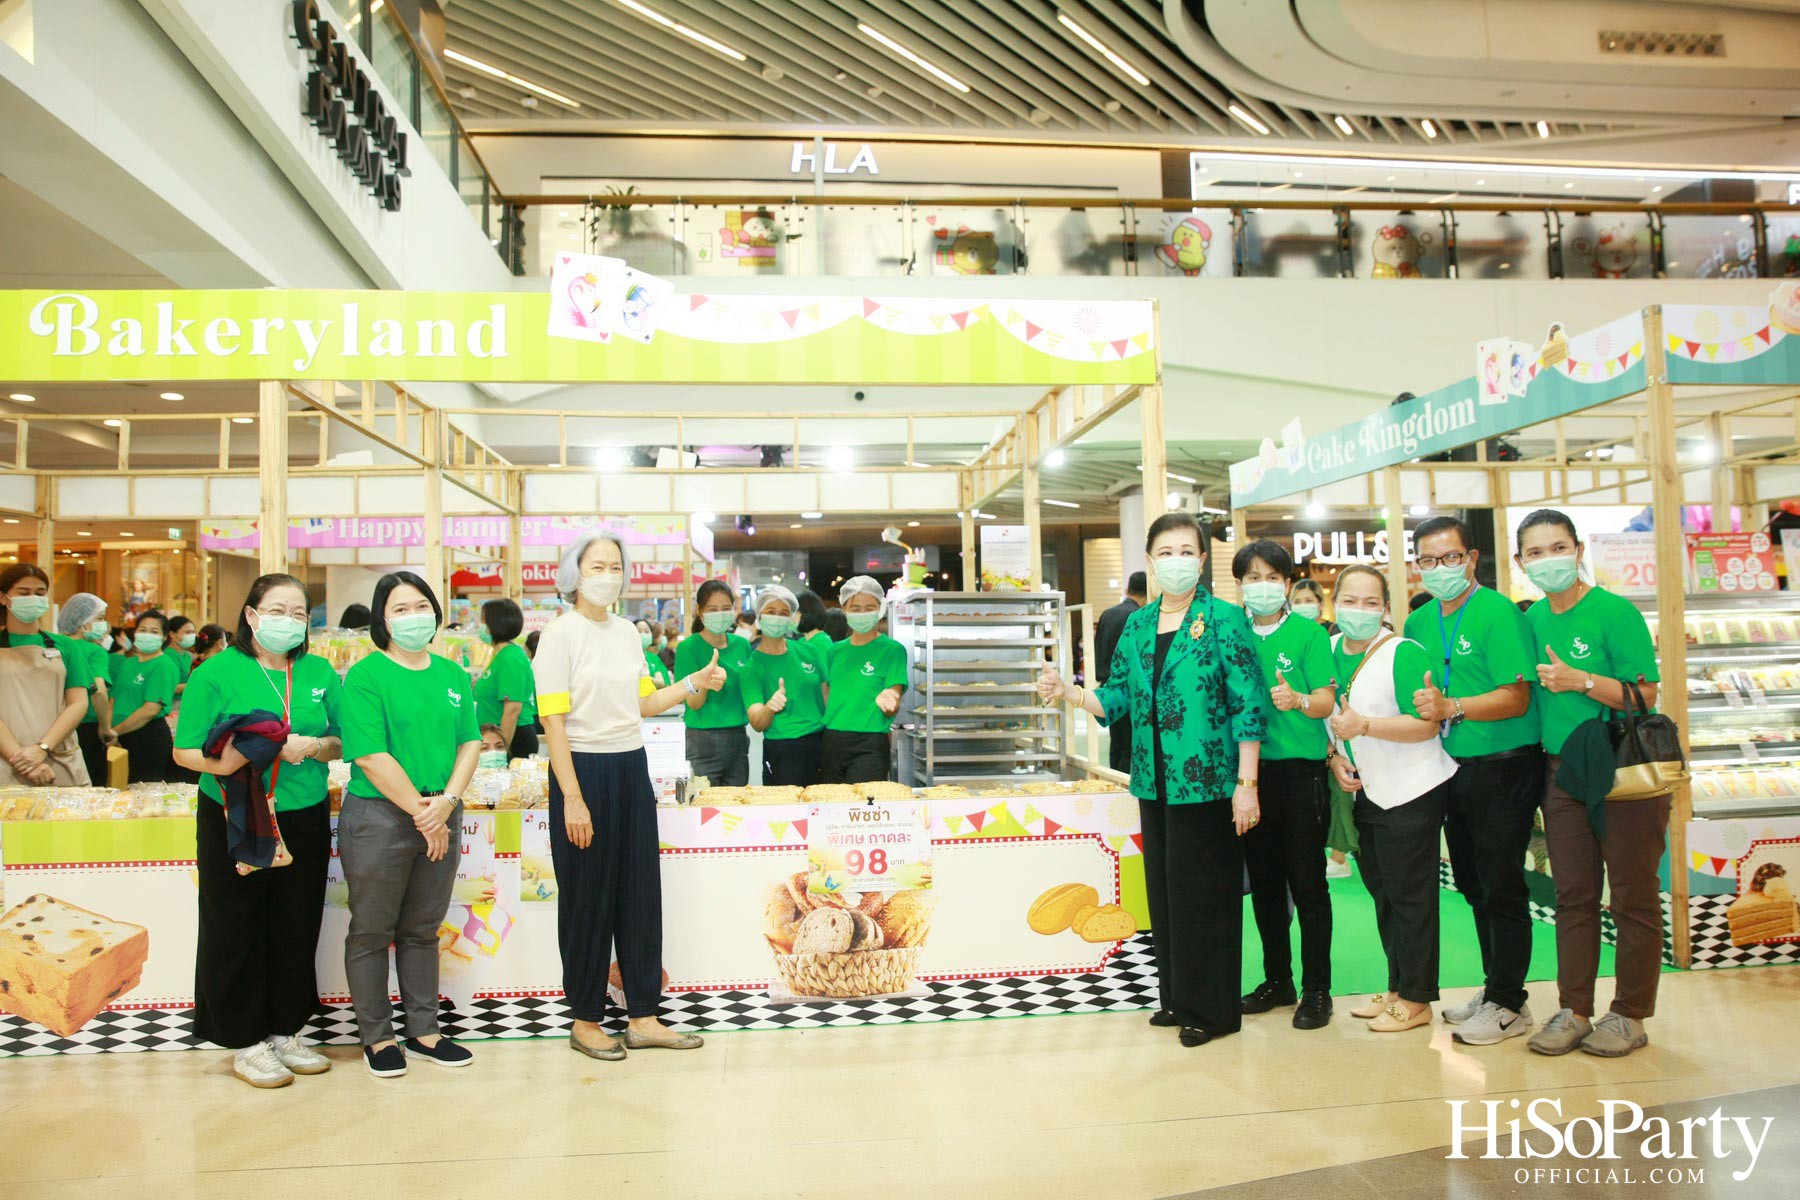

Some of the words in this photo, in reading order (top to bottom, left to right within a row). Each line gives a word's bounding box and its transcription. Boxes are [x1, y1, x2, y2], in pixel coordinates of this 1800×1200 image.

[293, 0, 412, 177] CENTRAL
[791, 142, 879, 175] HLA
[29, 293, 508, 372] Bakeryland
[1306, 434, 1356, 474] Cake
[1358, 397, 1476, 455] Kingdom
[338, 517, 425, 545] Happy
[848, 806, 890, 822] พิซซ่า
[827, 832, 865, 845] พิเศษ
[845, 849, 888, 876] 98
